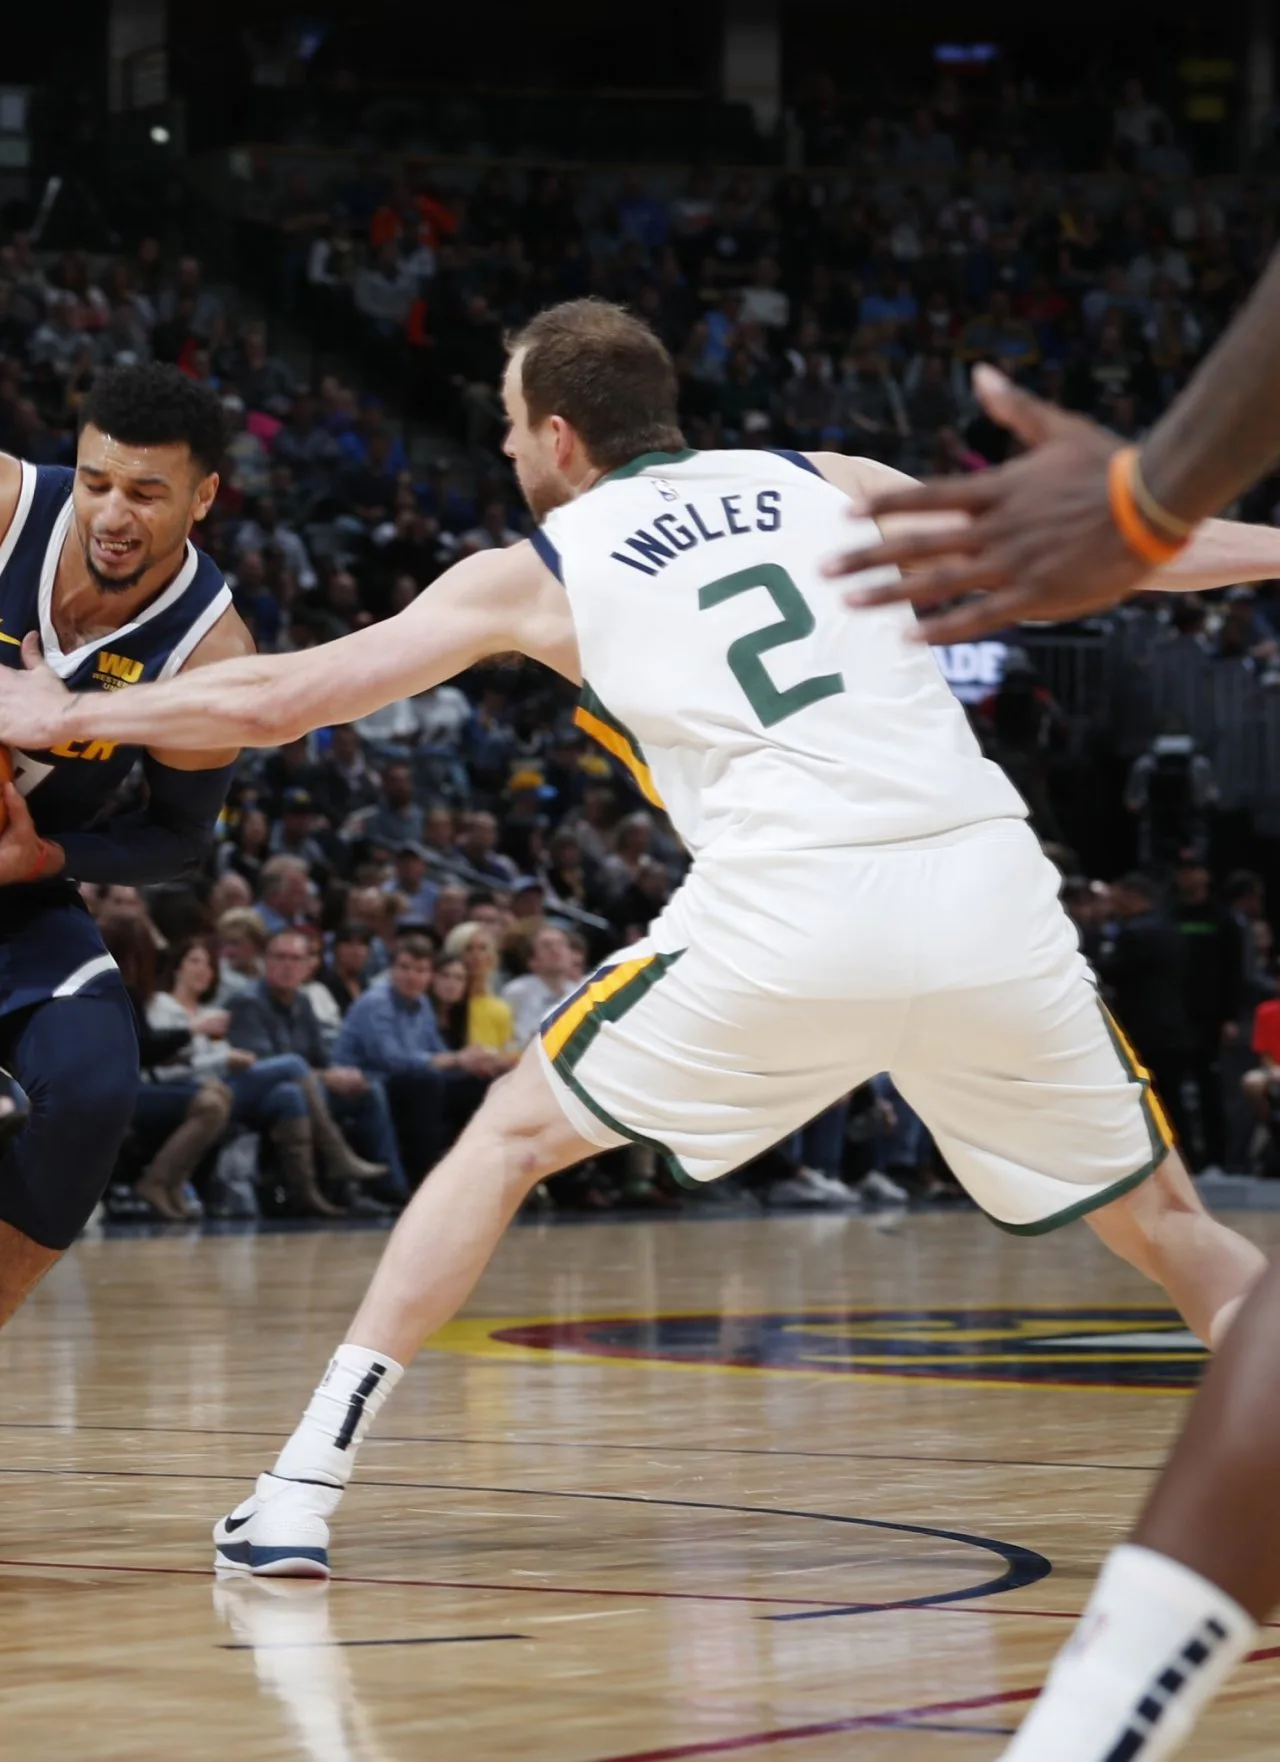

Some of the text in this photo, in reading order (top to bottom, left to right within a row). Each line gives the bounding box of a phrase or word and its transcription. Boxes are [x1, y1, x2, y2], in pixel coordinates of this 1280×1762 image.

[610, 490, 782, 577] INGLES
[98, 651, 144, 683] WU
[698, 563, 846, 729] 2
